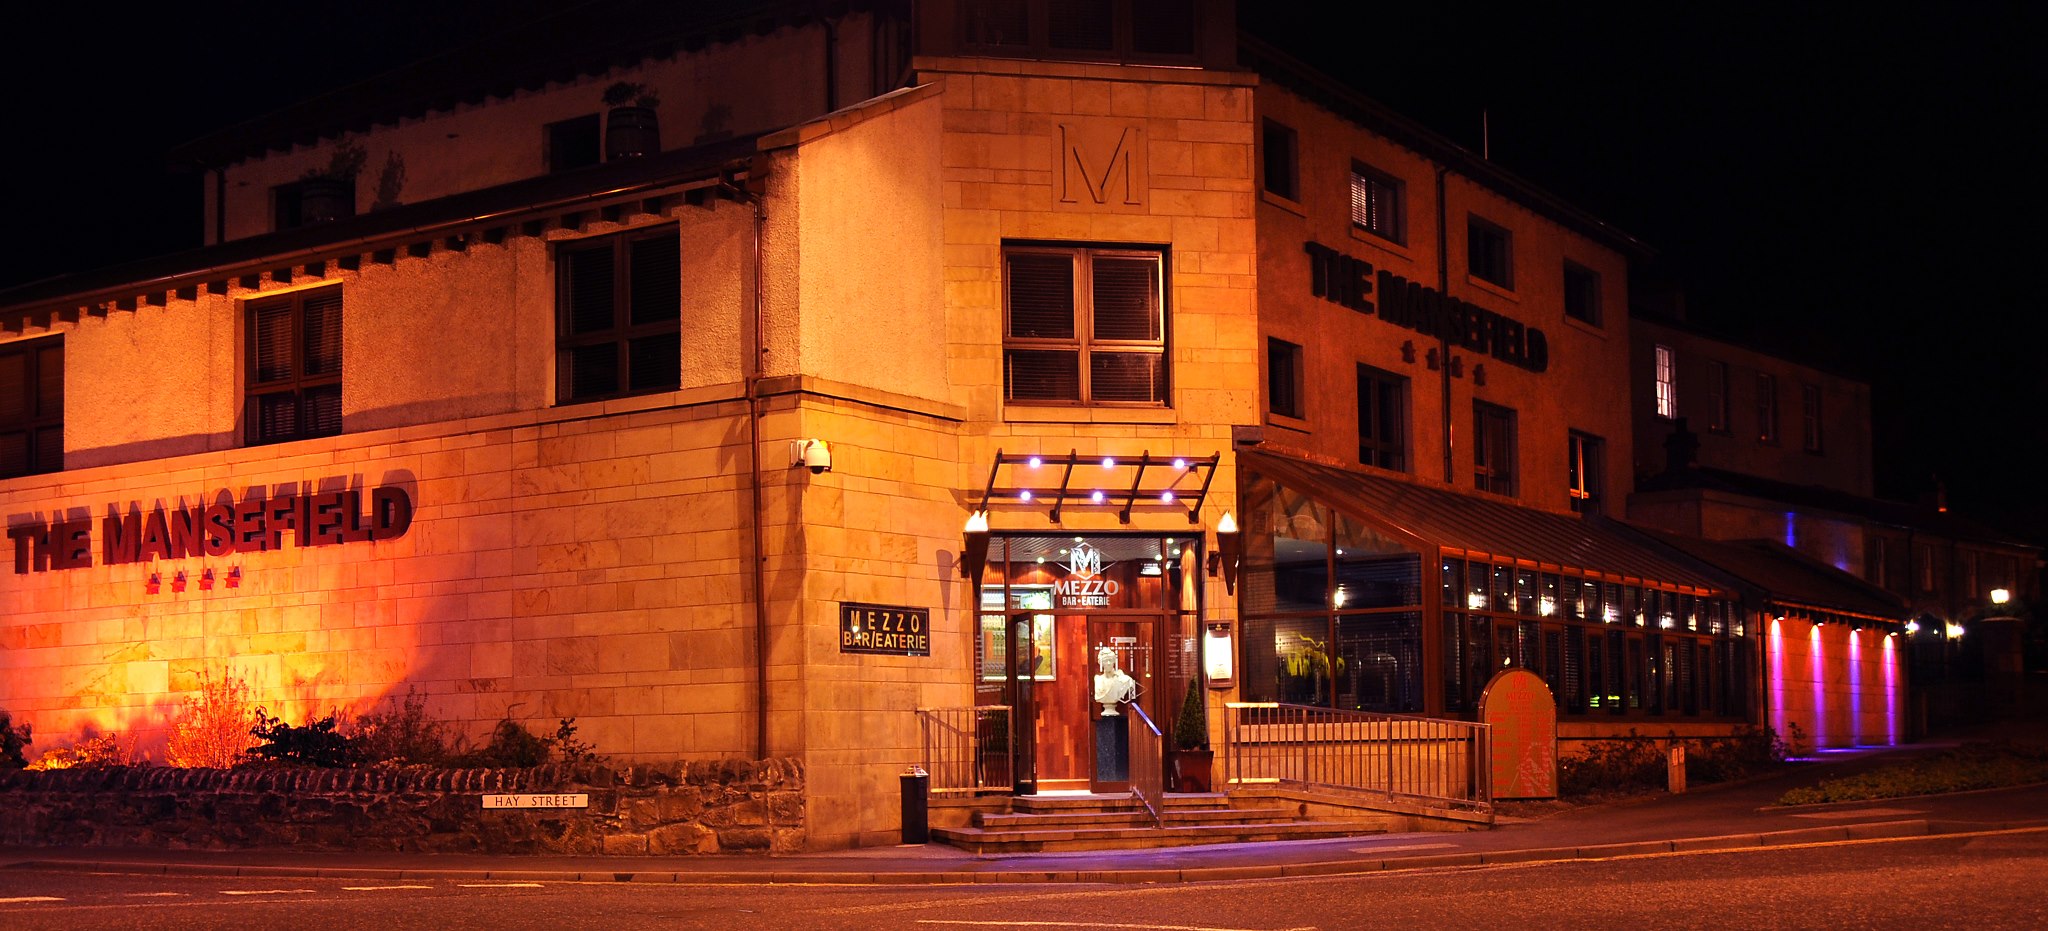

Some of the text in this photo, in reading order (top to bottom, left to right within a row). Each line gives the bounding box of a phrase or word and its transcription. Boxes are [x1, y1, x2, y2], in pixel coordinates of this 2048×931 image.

[1059, 125, 1141, 206] M
[1304, 240, 1375, 314] THE
[7, 486, 413, 575] THE MANSEFIELD
[1053, 579, 1119, 596] MEZZO
[850, 610, 919, 632] MEZZO
[843, 631, 926, 649] BAR/EATERIE
[495, 795, 577, 807] HAY STREET
